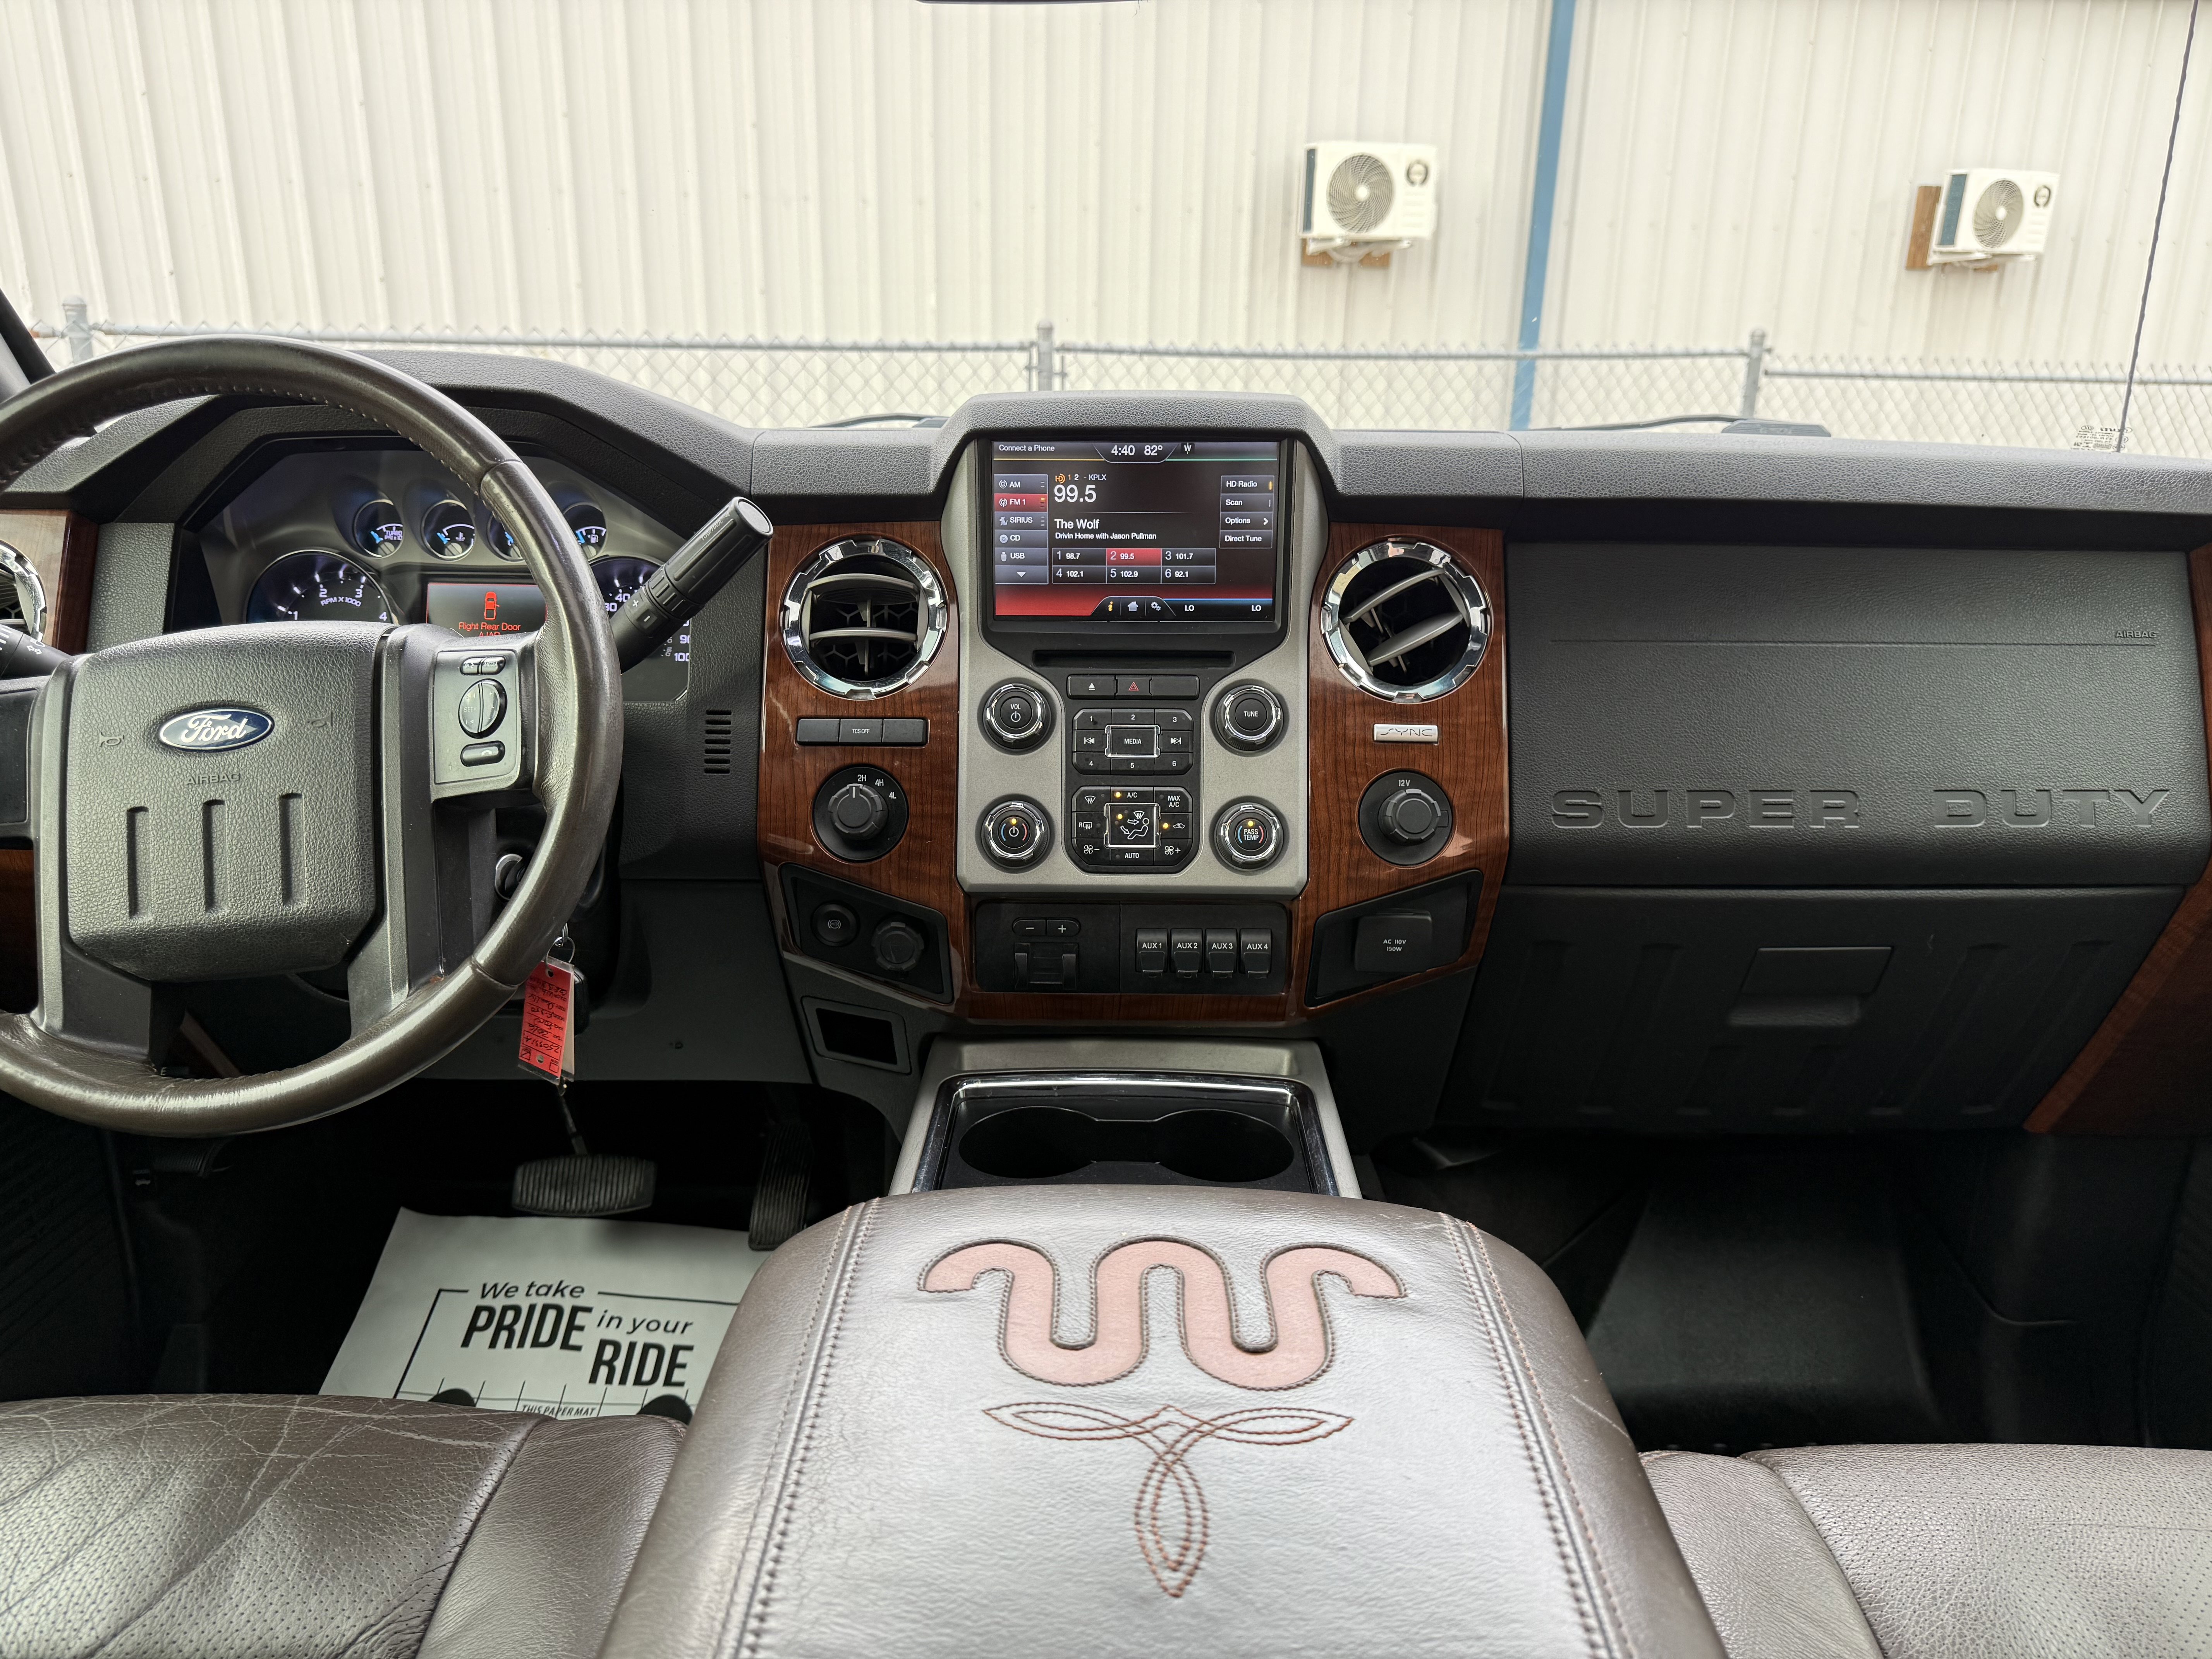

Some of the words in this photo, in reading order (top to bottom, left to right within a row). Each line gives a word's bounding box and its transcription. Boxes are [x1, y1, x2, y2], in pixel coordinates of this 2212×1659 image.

[1111, 445, 1135, 456] 4:40
[1054, 484, 1096, 502] 99.5
[1054, 519, 1073, 529] The
[1076, 519, 1100, 529] Wolf
[1057, 551, 1061, 560] 1
[1110, 551, 1117, 560] 2
[1165, 551, 1172, 560] 3
[1056, 569, 1063, 578] 4
[1110, 569, 1117, 578] 5
[1165, 569, 1171, 578] 6
[319, 589, 327, 598] 2
[355, 589, 362, 598] 3
[615, 593, 630, 602] 40
[320, 597, 337, 606] RPM
[345, 597, 362, 607] 1000
[293, 611, 298, 620] 1
[379, 611, 387, 621] 4
[459, 622, 479, 631] Right
[481, 622, 500, 630] Rear
[501, 622, 521, 630] Door
[180, 714, 248, 743] Ford
[1381, 728, 1433, 737] SYNC
[185, 773, 240, 785] AIRBAG
[1552, 789, 1860, 828] SUPER
[1934, 789, 2170, 828] DUTY
[480, 1282, 519, 1299] We
[525, 1280, 585, 1298] take
[596, 1309, 623, 1329] in
[626, 1317, 694, 1335] your
[461, 1303, 594, 1352] PRIDE
[588, 1338, 694, 1387] RIDE
[523, 1404, 541, 1414] THIS
[544, 1406, 574, 1417] PAPER
[575, 1407, 596, 1417] MAT
